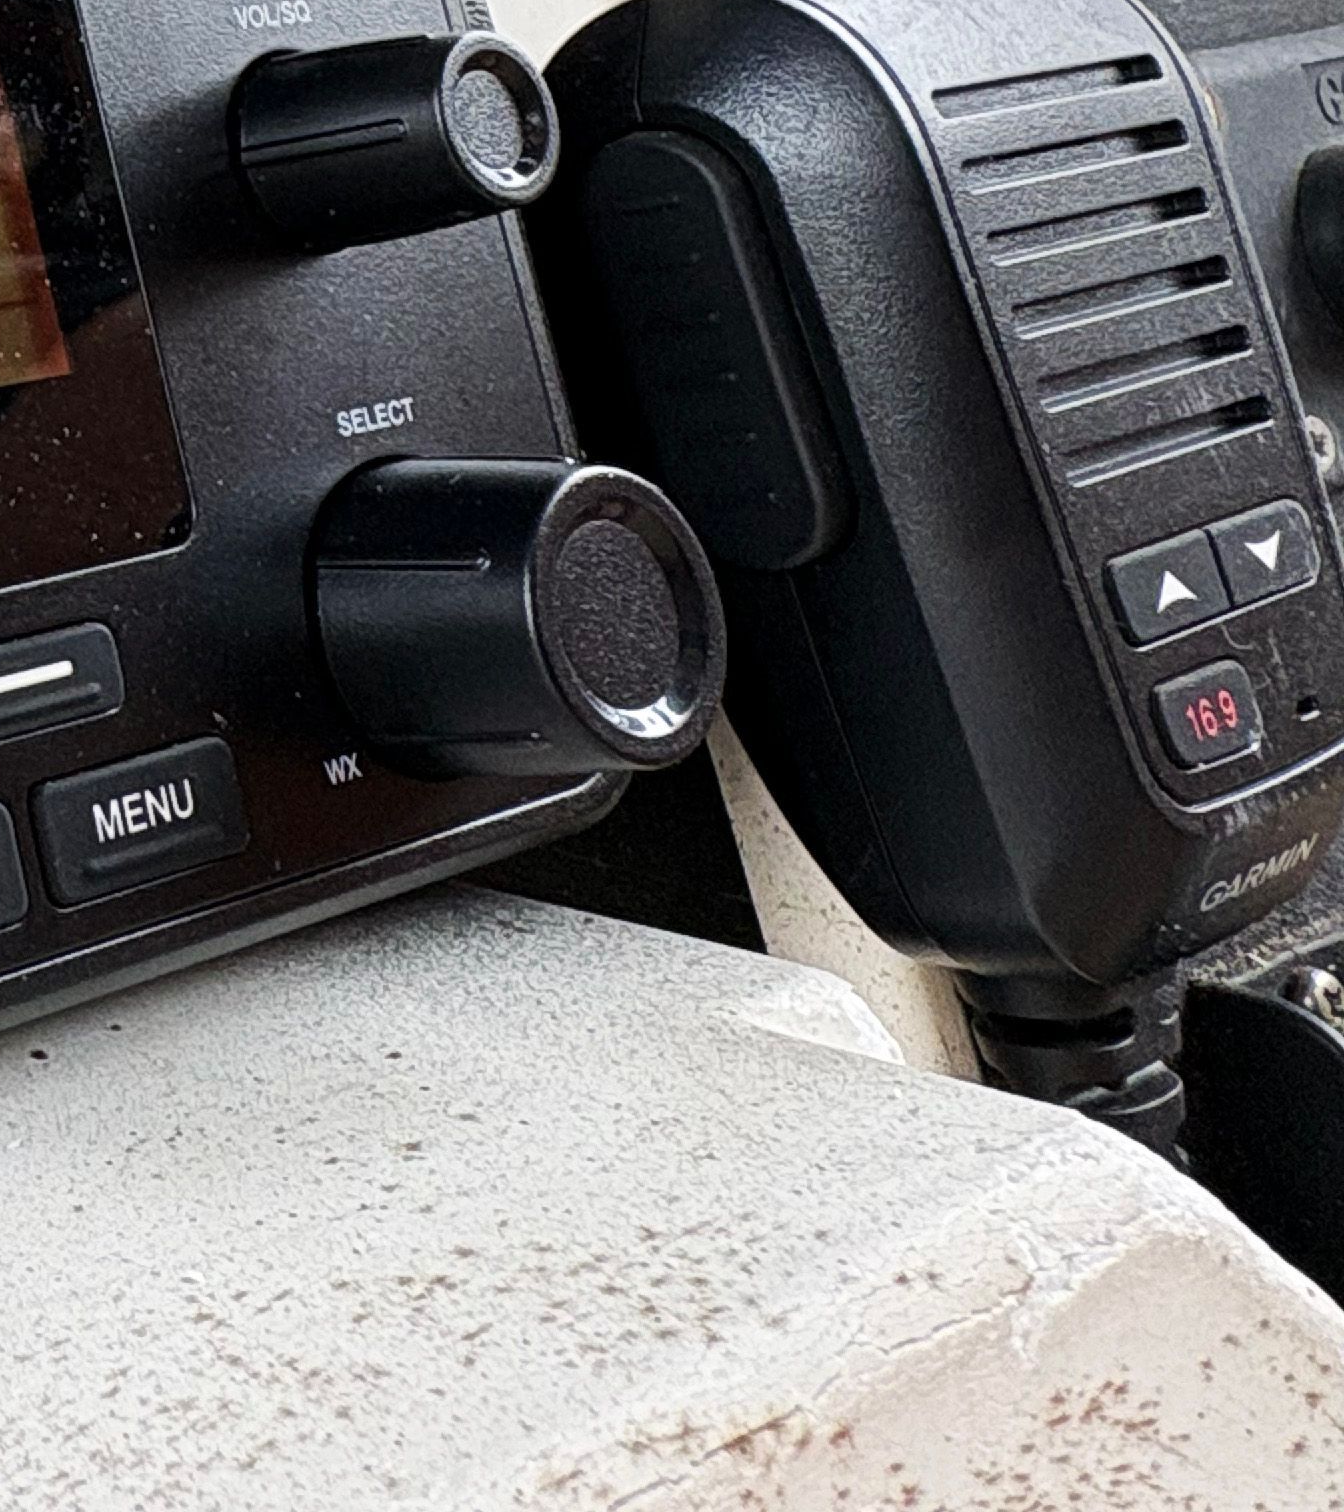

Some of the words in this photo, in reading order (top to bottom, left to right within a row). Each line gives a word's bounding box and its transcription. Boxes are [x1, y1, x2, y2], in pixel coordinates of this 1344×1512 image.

[233, 0, 313, 29] VOL/SQ
[336, 396, 415, 437] SELECT
[324, 752, 363, 786] WX
[91, 778, 196, 845] MENU
[1199, 832, 1320, 914] GARMIN
